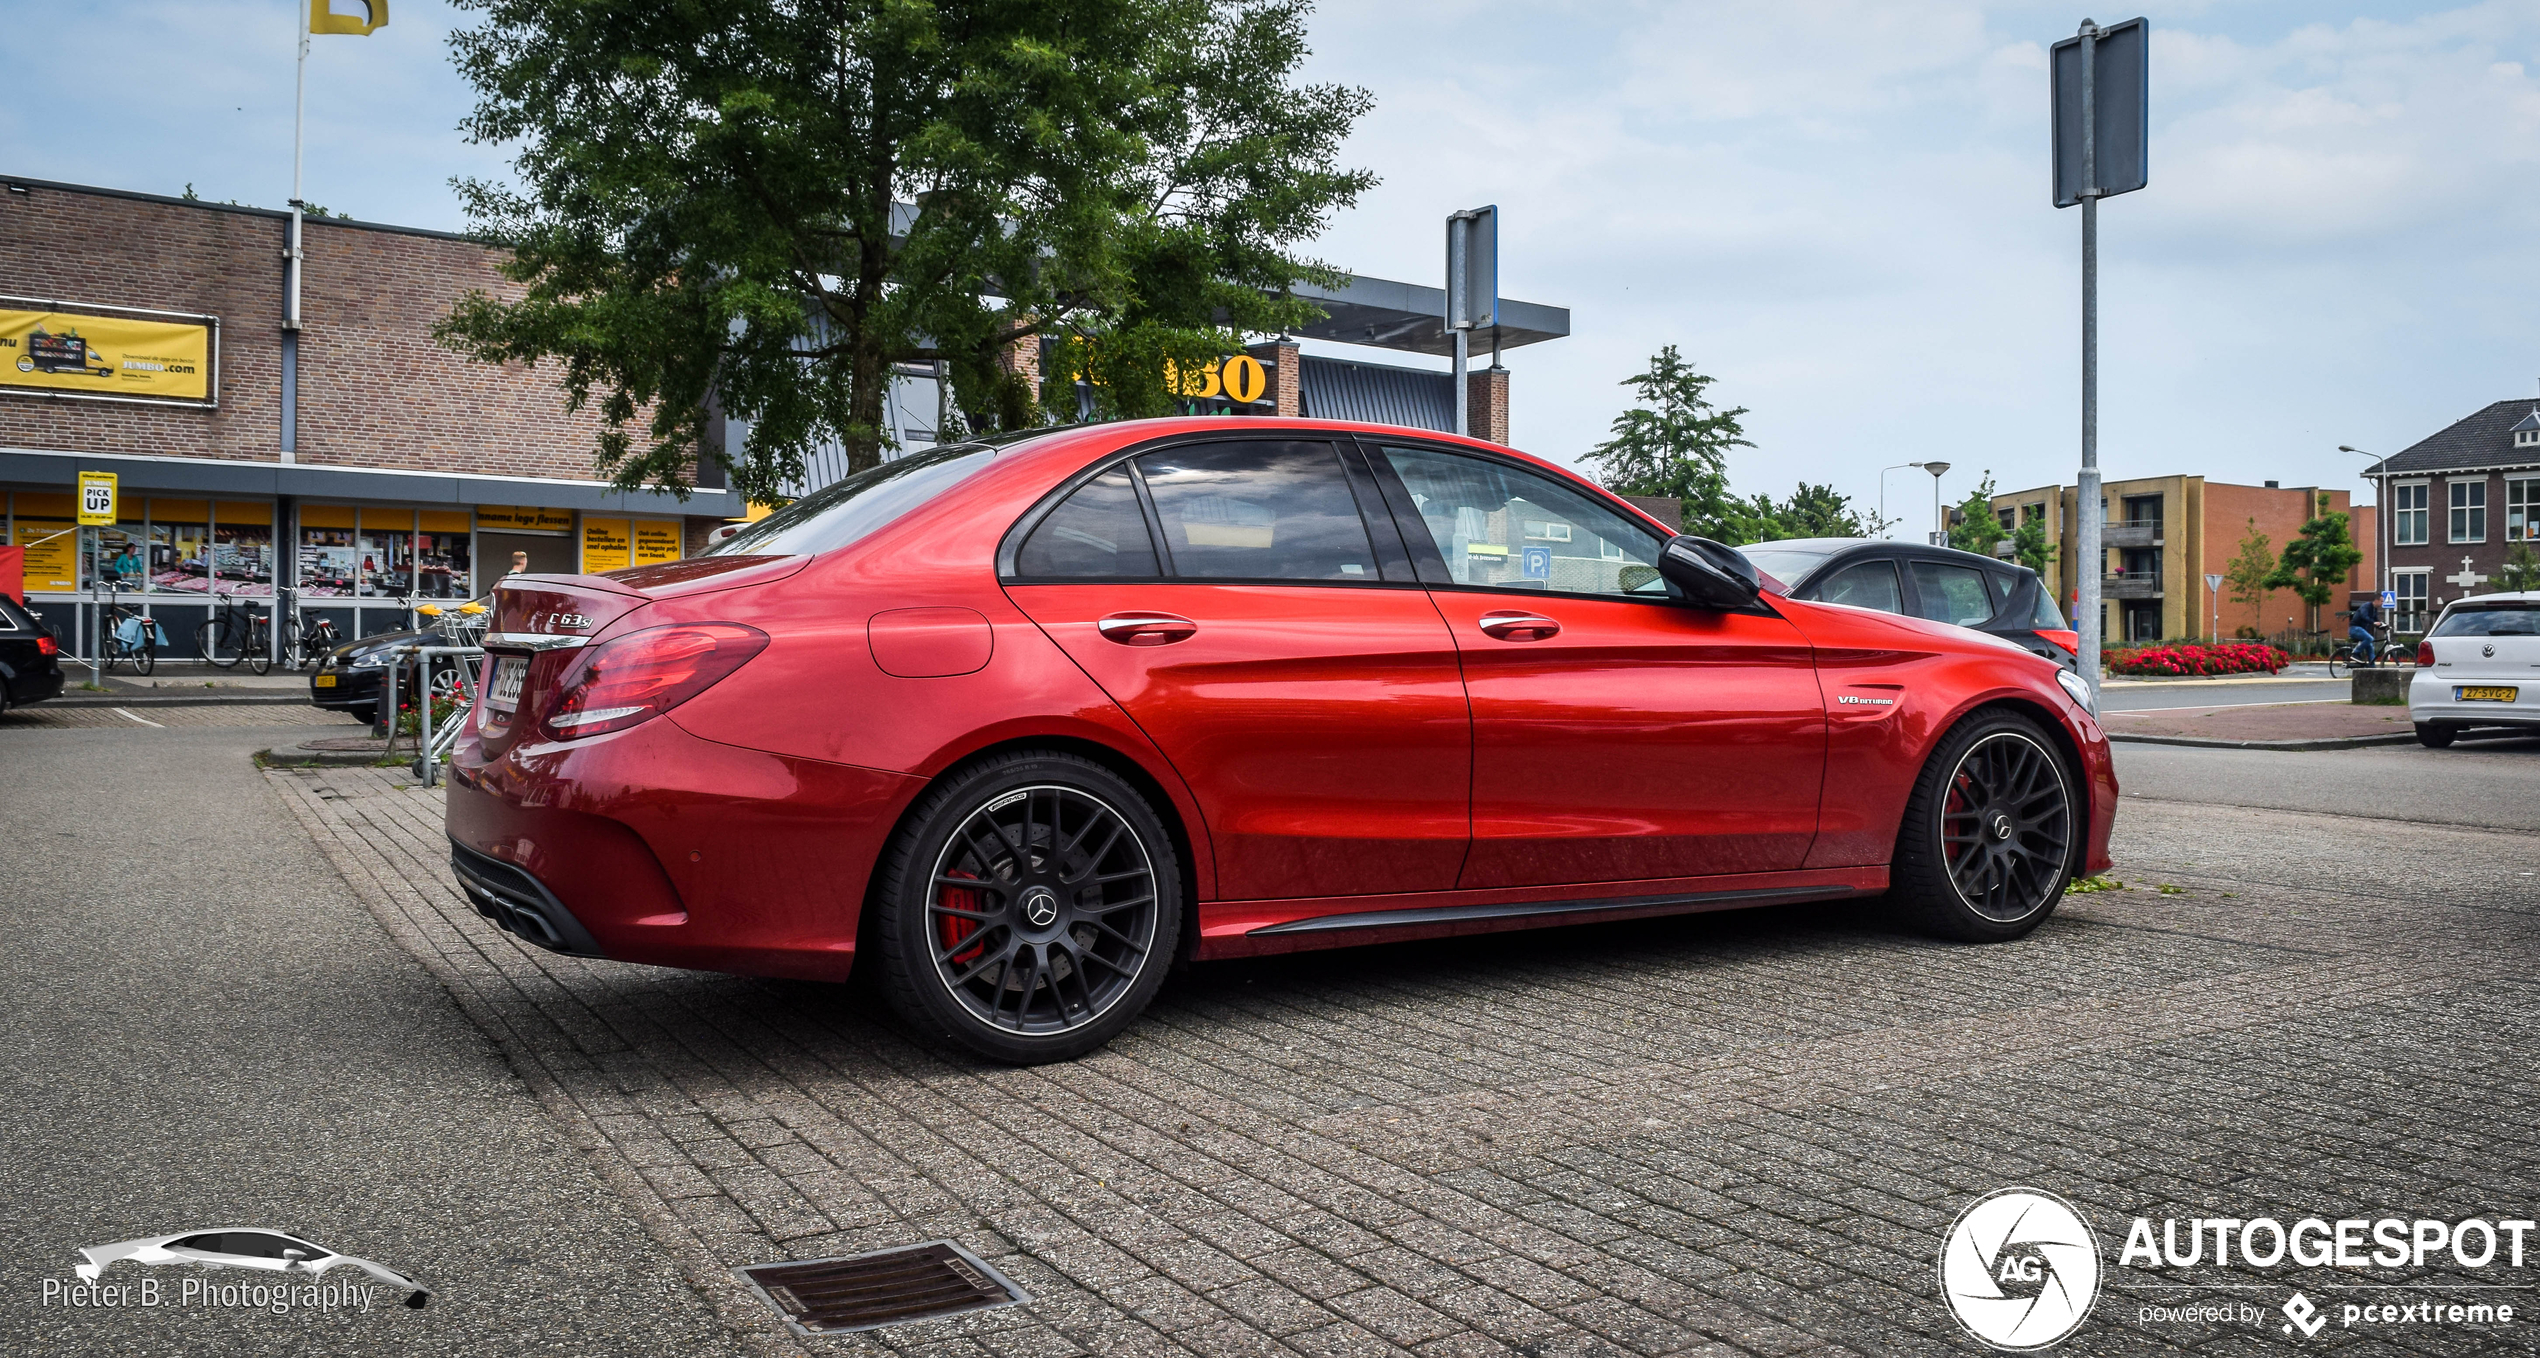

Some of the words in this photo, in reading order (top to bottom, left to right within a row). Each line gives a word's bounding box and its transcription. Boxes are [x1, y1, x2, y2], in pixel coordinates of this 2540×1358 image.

[86, 489, 109, 497] PICK
[86, 498, 110, 511] UP
[514, 512, 535, 525] lege
[535, 514, 570, 526] flessen
[586, 535, 616, 543] bestellen
[549, 613, 560, 625] C
[2466, 688, 2513, 698] 27-SVG-2
[1837, 695, 1859, 704] V8
